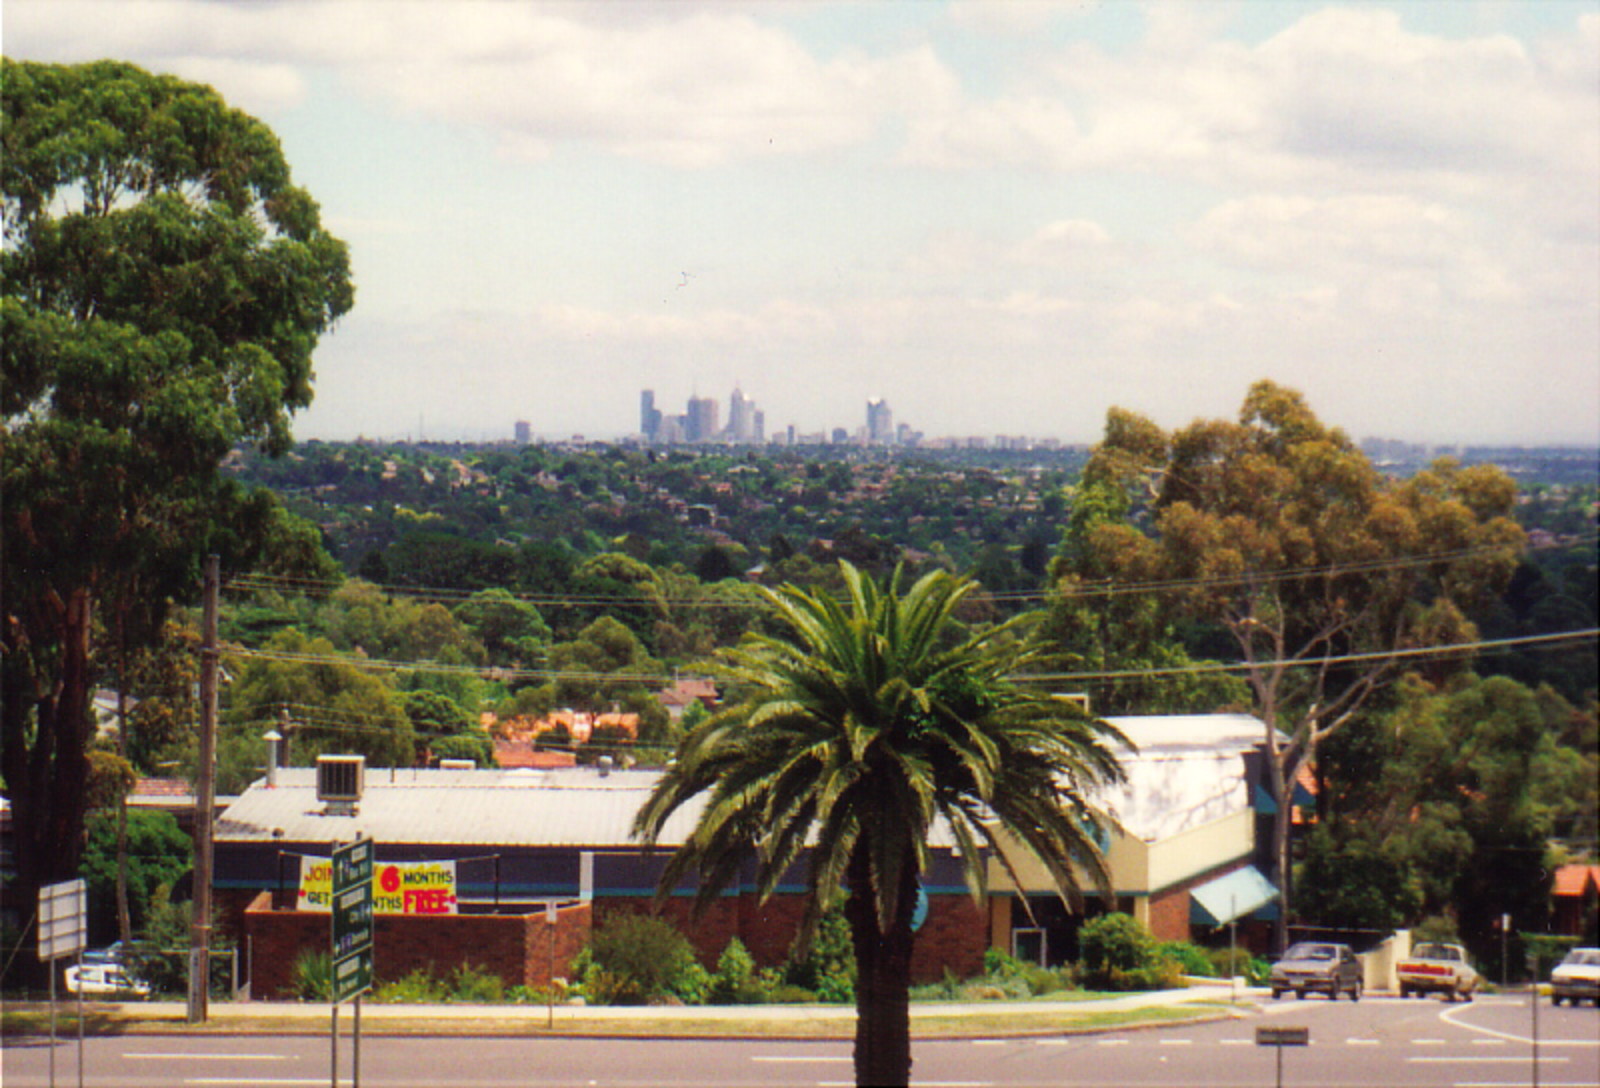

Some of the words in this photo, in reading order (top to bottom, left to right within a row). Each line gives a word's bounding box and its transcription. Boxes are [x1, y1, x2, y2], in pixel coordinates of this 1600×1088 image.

[380, 865, 400, 892] 6
[404, 871, 453, 884] MONTHS
[308, 891, 329, 905] GET
[372, 896, 402, 910] NTHS
[403, 889, 449, 914] FREE
